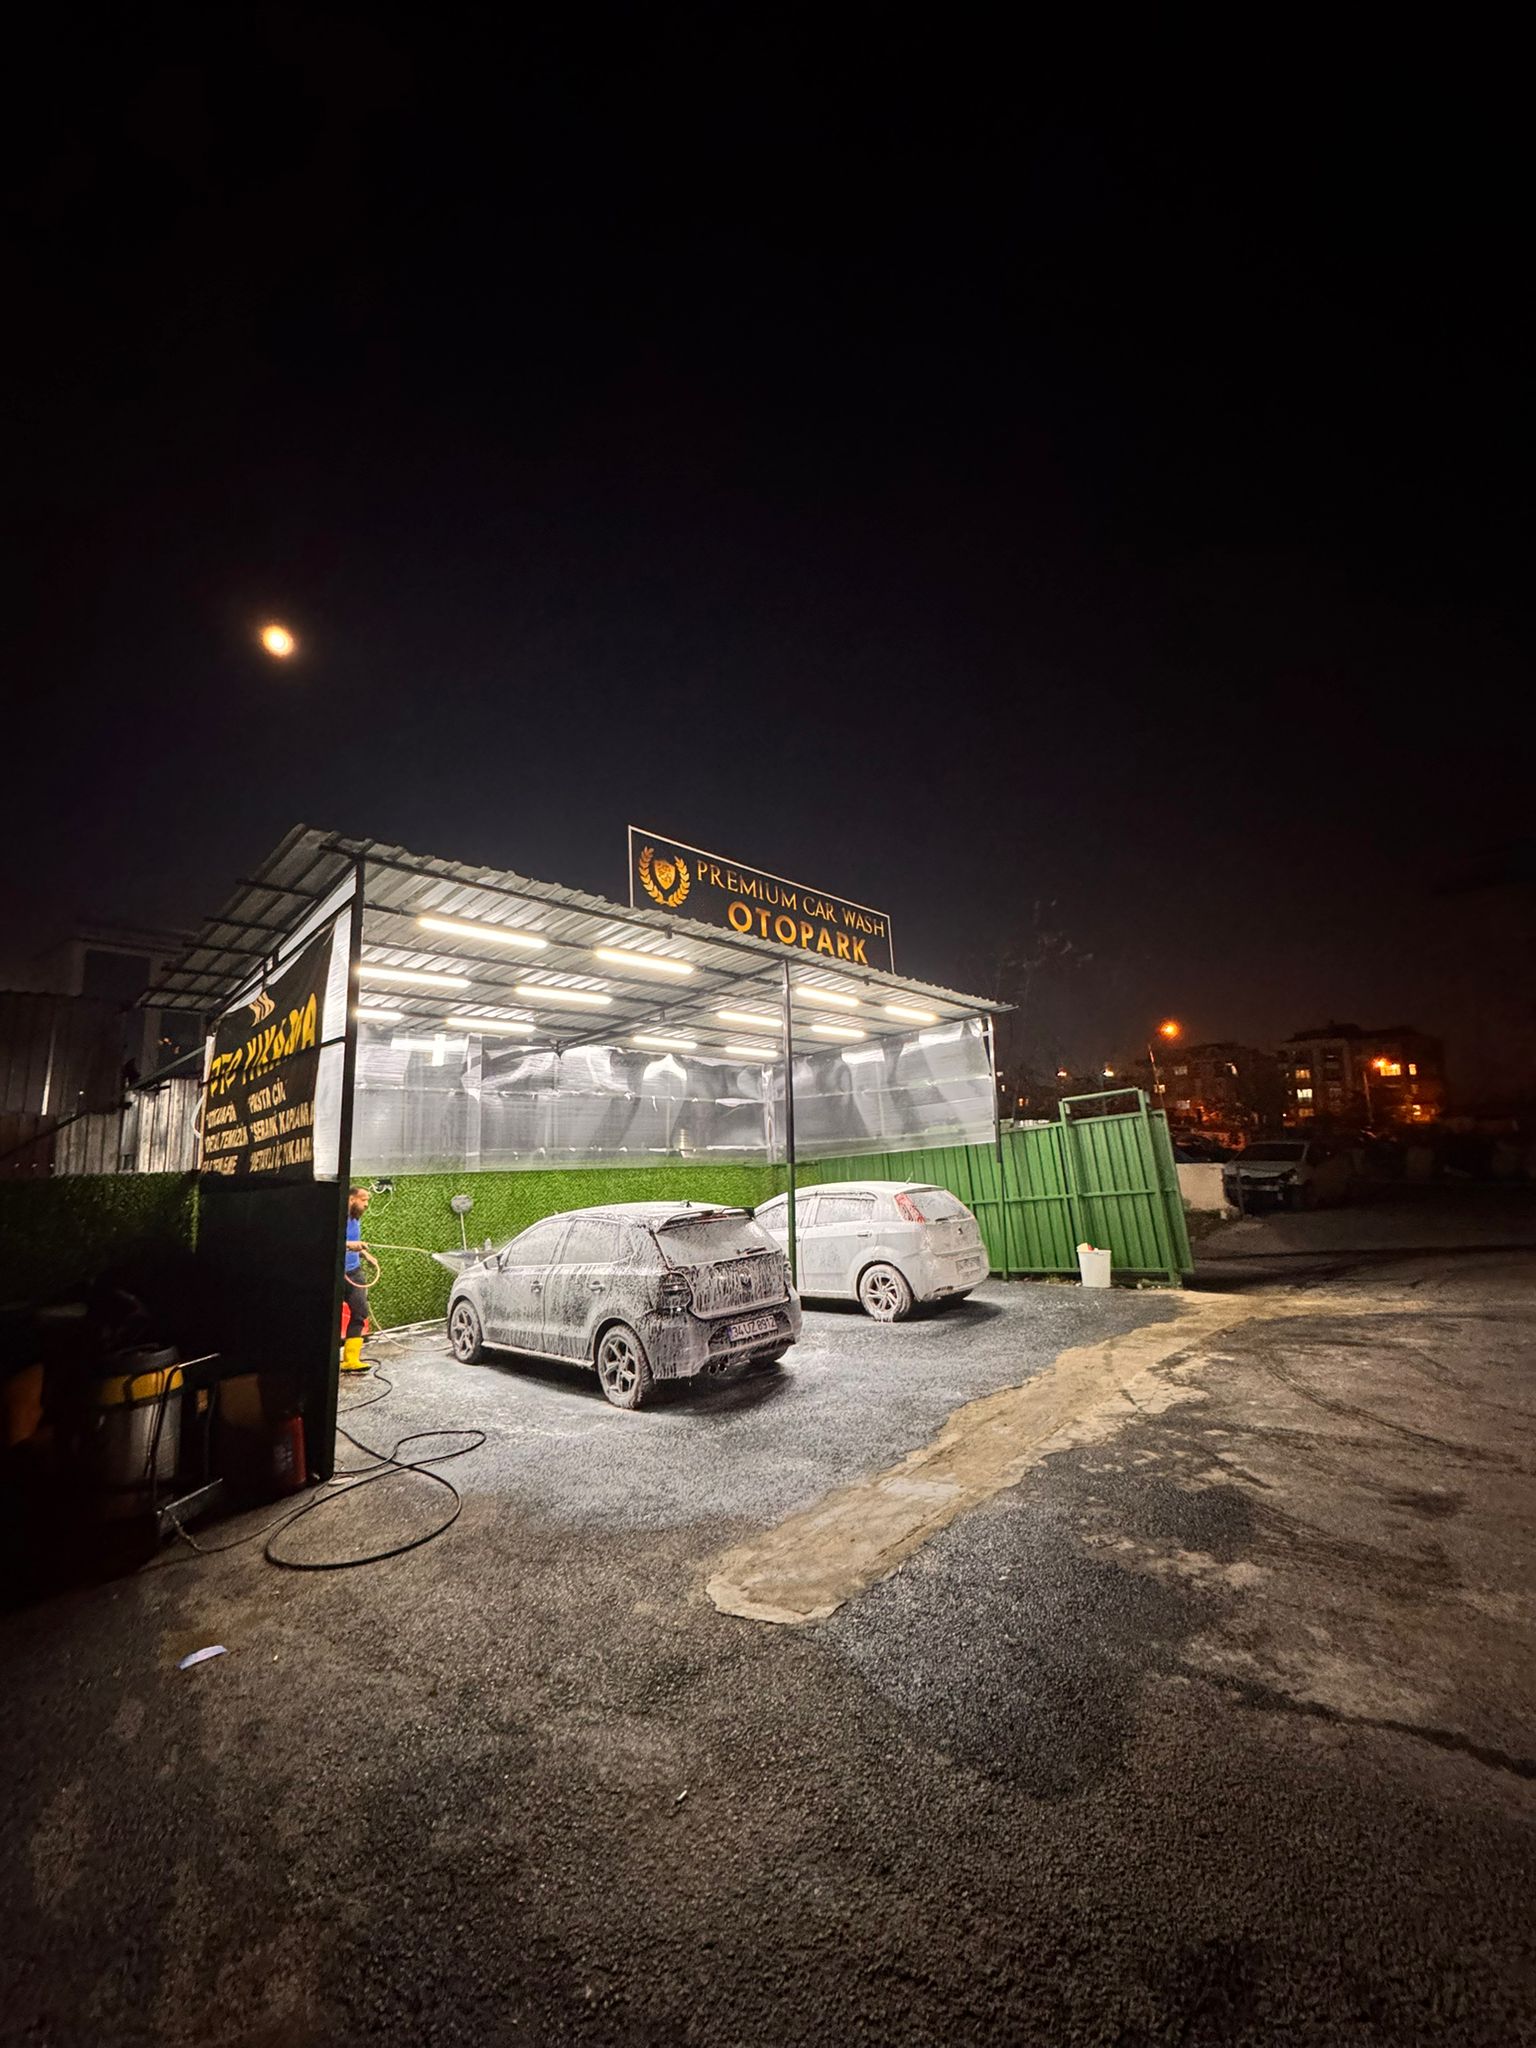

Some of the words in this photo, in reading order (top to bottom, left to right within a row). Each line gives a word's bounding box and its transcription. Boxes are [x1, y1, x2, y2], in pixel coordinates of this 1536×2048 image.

[697, 859, 798, 911] PREMIUM
[802, 895, 838, 924] CAR
[841, 907, 885, 938] WASH
[727, 901, 869, 966] OTOPARK
[732, 1326, 744, 1338] 34
